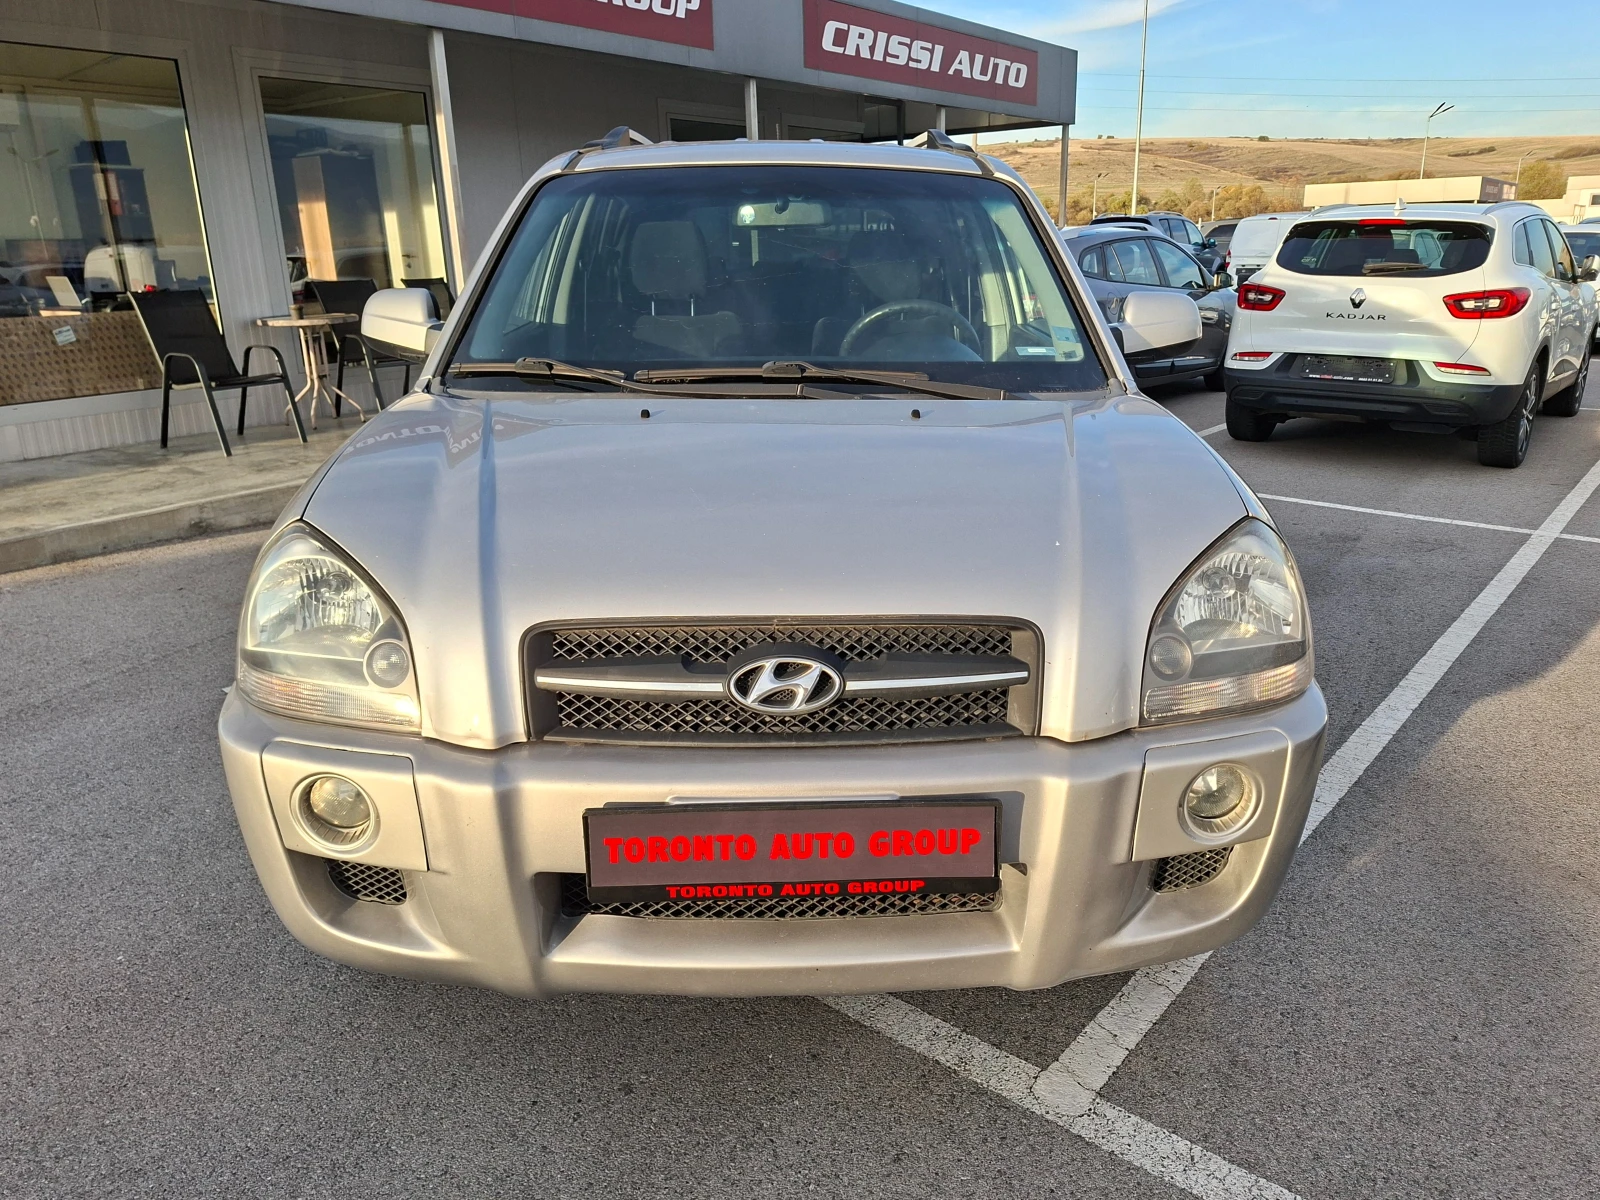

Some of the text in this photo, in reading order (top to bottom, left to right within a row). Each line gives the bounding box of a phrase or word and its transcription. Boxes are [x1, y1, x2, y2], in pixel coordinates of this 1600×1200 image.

[821, 20, 1028, 88] CRISSI AUTO
[1325, 312, 1387, 321] KADJAR
[603, 828, 981, 864] TORONTO AUTO GROUP
[666, 880, 925, 898] TORONTO AUTO GROUP
